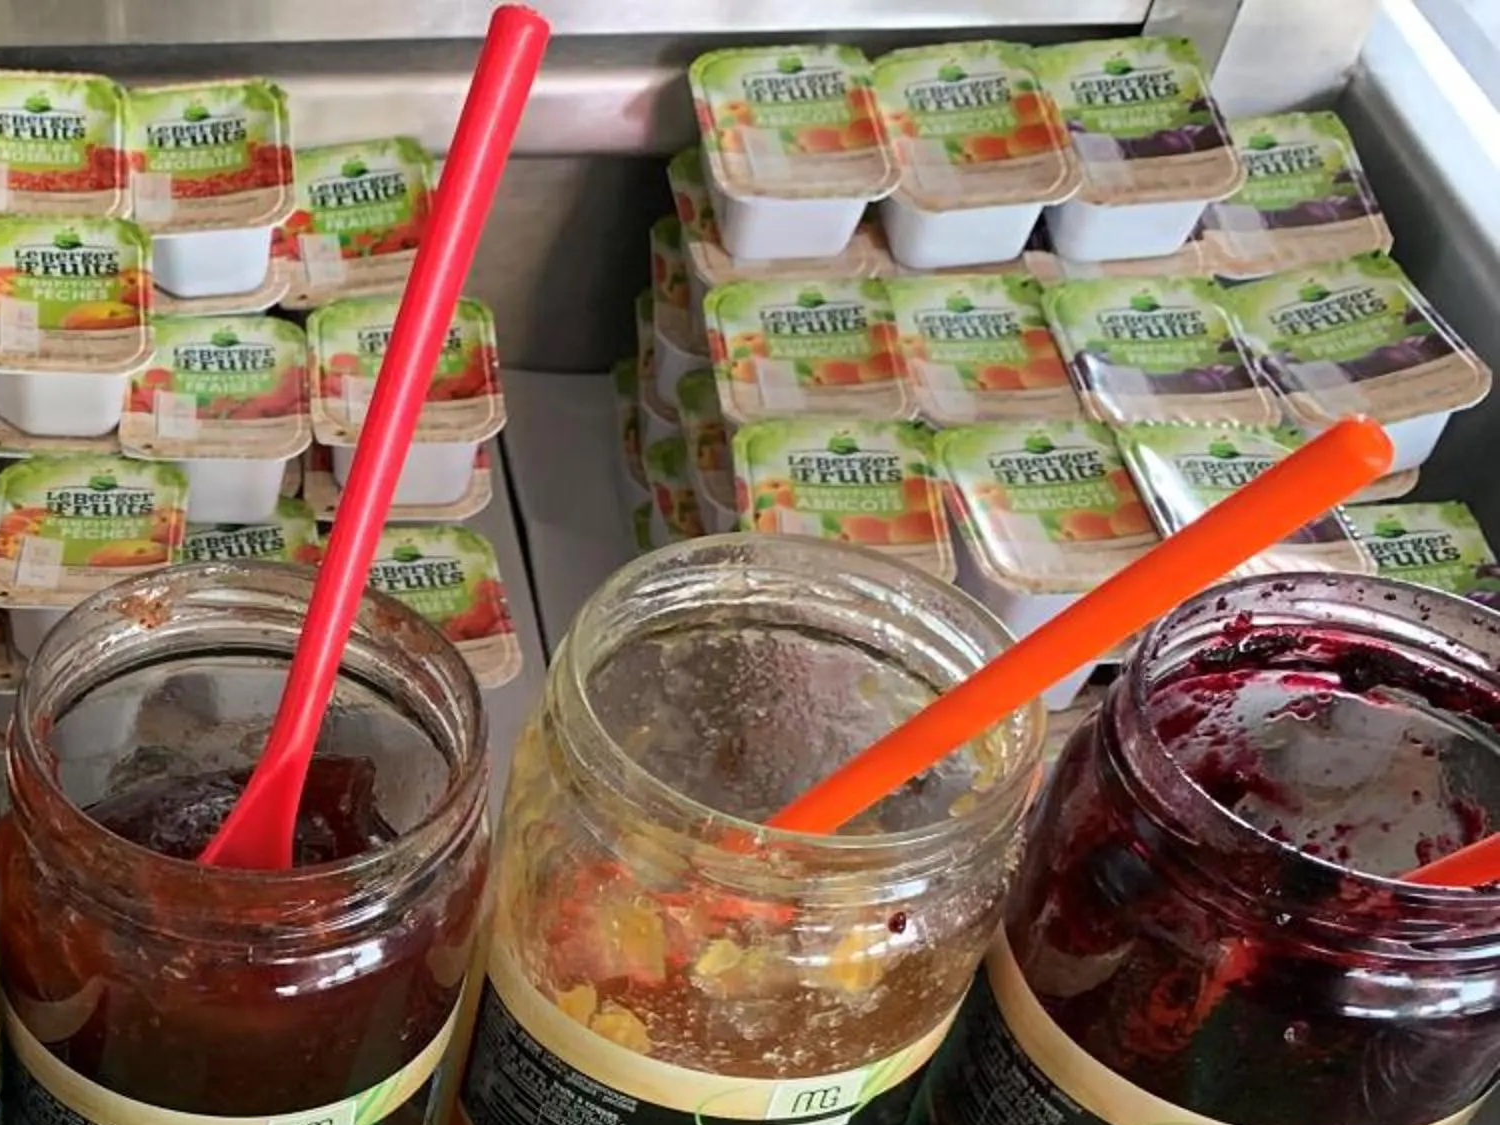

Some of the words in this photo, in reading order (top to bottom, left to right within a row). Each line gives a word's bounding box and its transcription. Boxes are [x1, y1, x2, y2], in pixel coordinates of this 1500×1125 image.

[800, 467, 903, 485] Fruits
[1005, 463, 1107, 485] Fruits
[57, 501, 155, 518] Fruits
